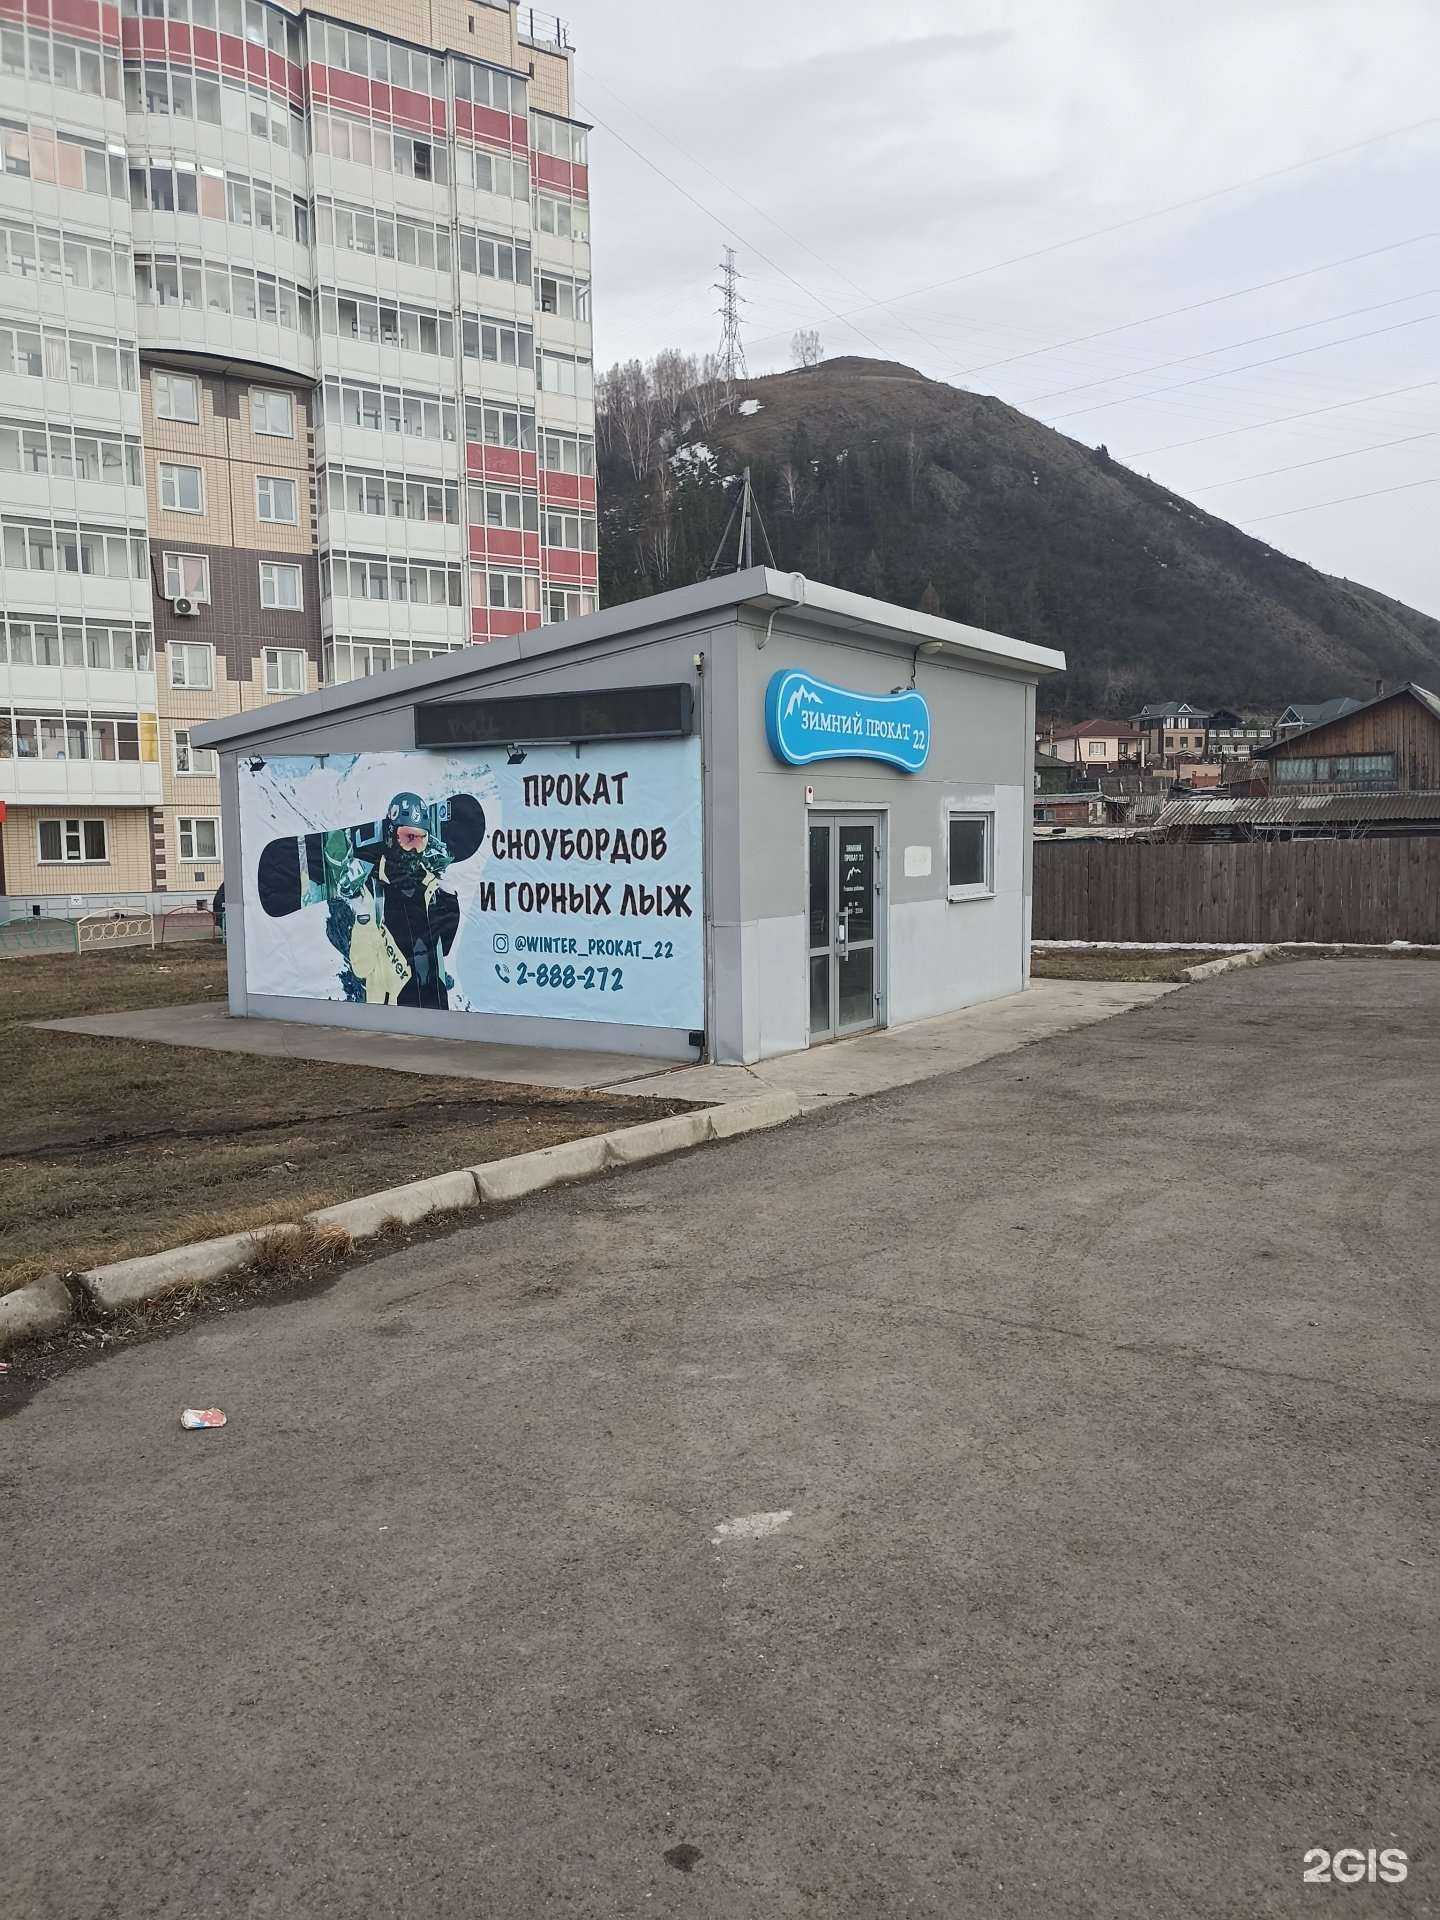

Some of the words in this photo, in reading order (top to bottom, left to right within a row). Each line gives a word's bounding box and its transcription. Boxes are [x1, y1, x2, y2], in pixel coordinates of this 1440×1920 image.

[801, 710, 863, 735] ЗИМНИЙ
[866, 719, 911, 740] ПРОКАТ
[912, 729, 925, 750] 22
[522, 771, 629, 806] ПРОКАТ
[491, 827, 668, 864] СНОУБОРДОВ
[479, 881, 496, 912] И
[504, 882, 612, 916] ГОРНЫХ
[619, 883, 693, 917] ЛЫЖ
[514, 935, 674, 960] @WINTER_PROKAT_22
[516, 961, 624, 992] 2-888-272
